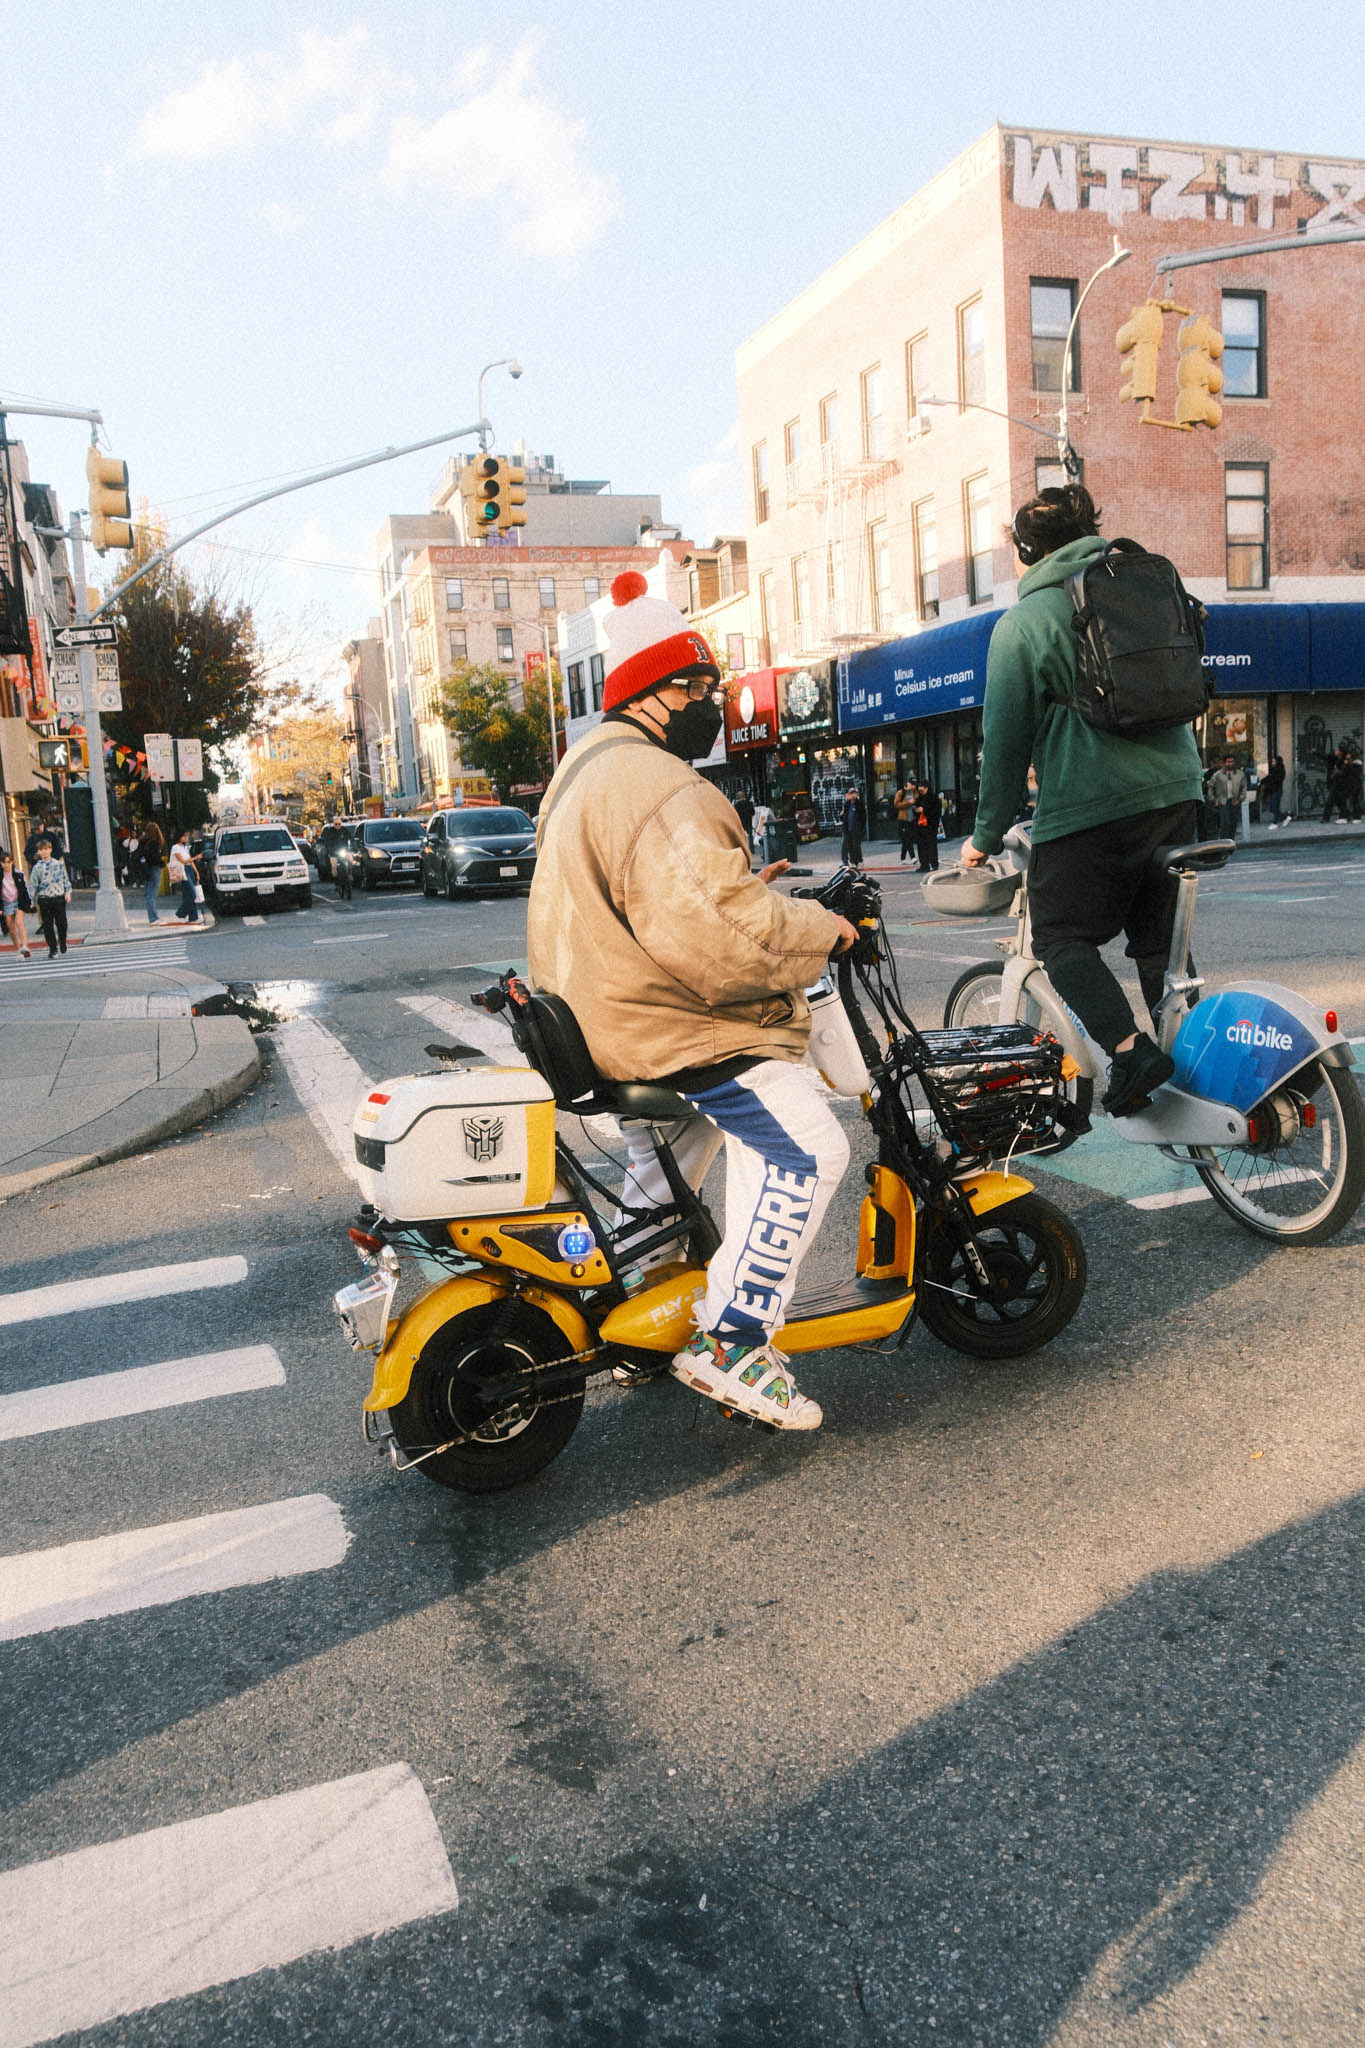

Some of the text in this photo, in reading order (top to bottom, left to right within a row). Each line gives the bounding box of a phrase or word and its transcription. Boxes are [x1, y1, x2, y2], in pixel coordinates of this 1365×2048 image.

[62, 630, 107, 642] ONE WAY
[1200, 654, 1251, 667] cream
[894, 667, 914, 682] Minus
[895, 669, 974, 697] Celsius ice cream
[731, 727, 749, 745] JUICE
[750, 723, 768, 742] TIME
